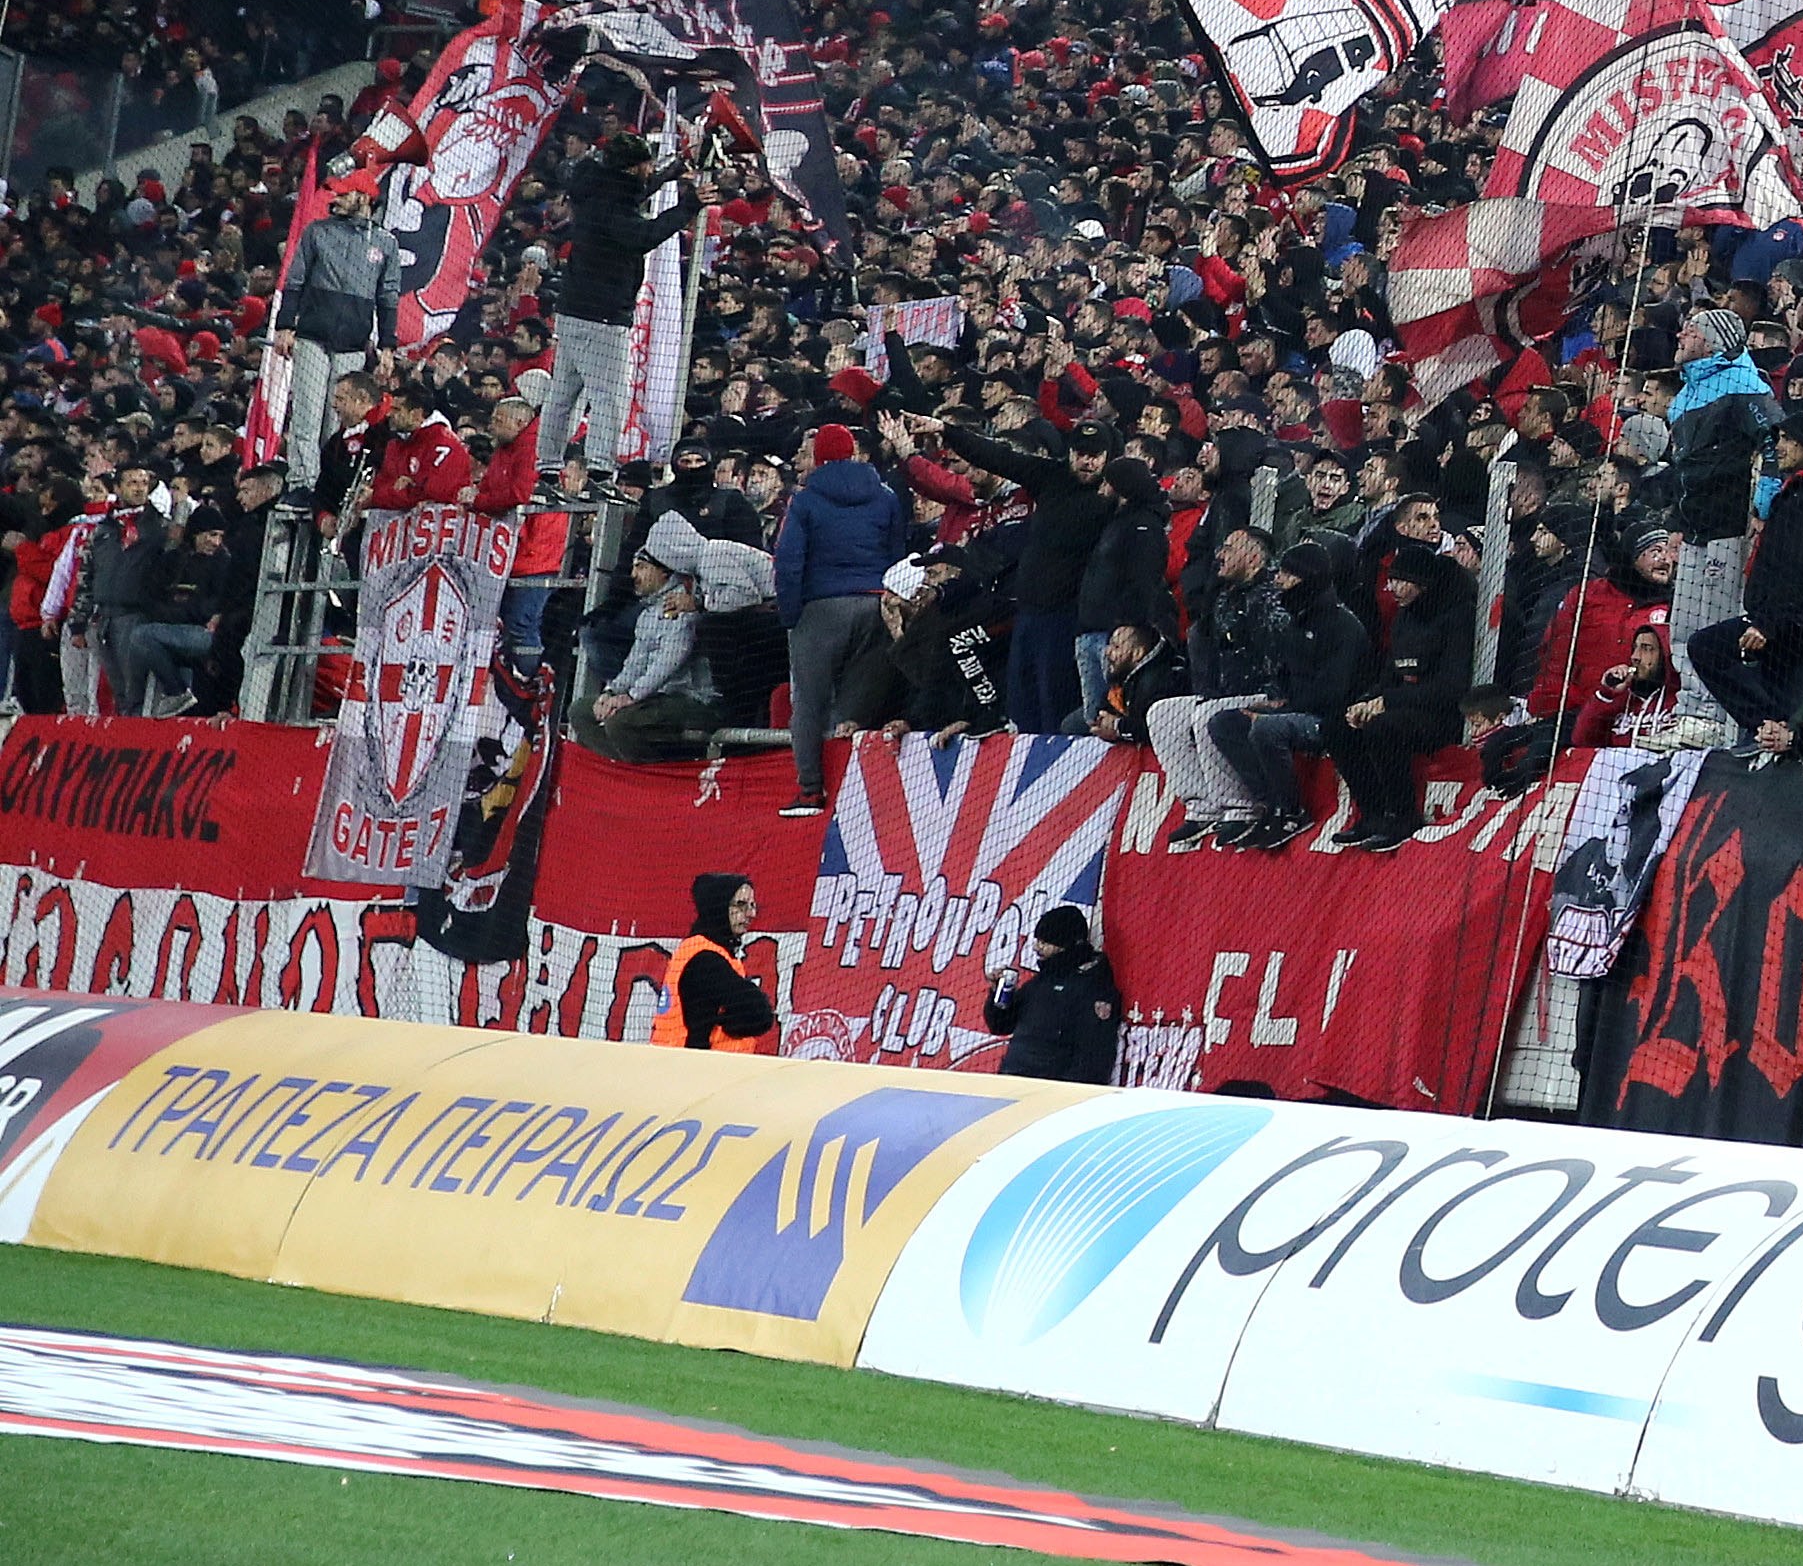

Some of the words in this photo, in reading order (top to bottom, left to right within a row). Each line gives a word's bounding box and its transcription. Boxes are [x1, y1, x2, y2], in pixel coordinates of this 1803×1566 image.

[364, 509, 516, 580] MISFITS
[330, 802, 420, 870] GATE
[424, 806, 448, 858] 7
[870, 983, 957, 1057] CLUB
[107, 1064, 402, 1182] ΤΡΑΠΕΖΑ
[406, 1094, 760, 1222] ΠΕΙΡΑΙΩΣ
